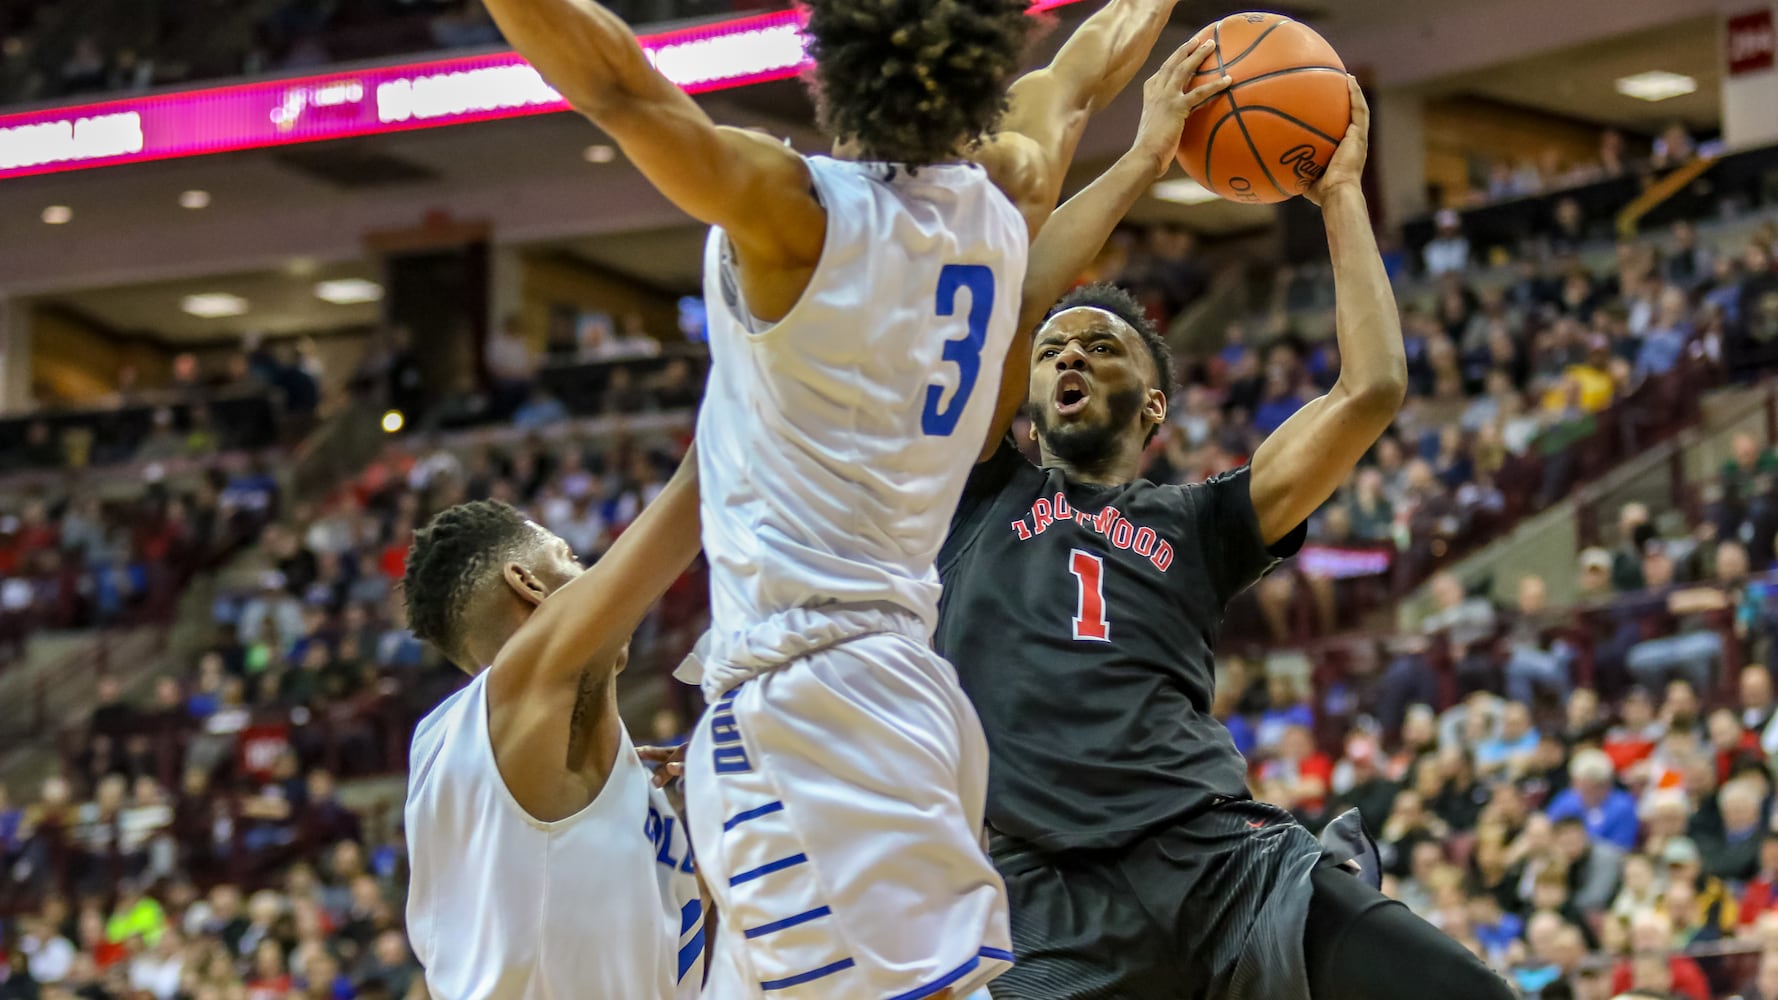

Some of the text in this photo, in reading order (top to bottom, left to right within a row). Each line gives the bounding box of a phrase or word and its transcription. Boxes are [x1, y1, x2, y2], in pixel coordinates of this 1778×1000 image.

[921, 265, 995, 436] 3
[1012, 492, 1174, 572] TROTWOOD
[1068, 548, 1111, 642] 1
